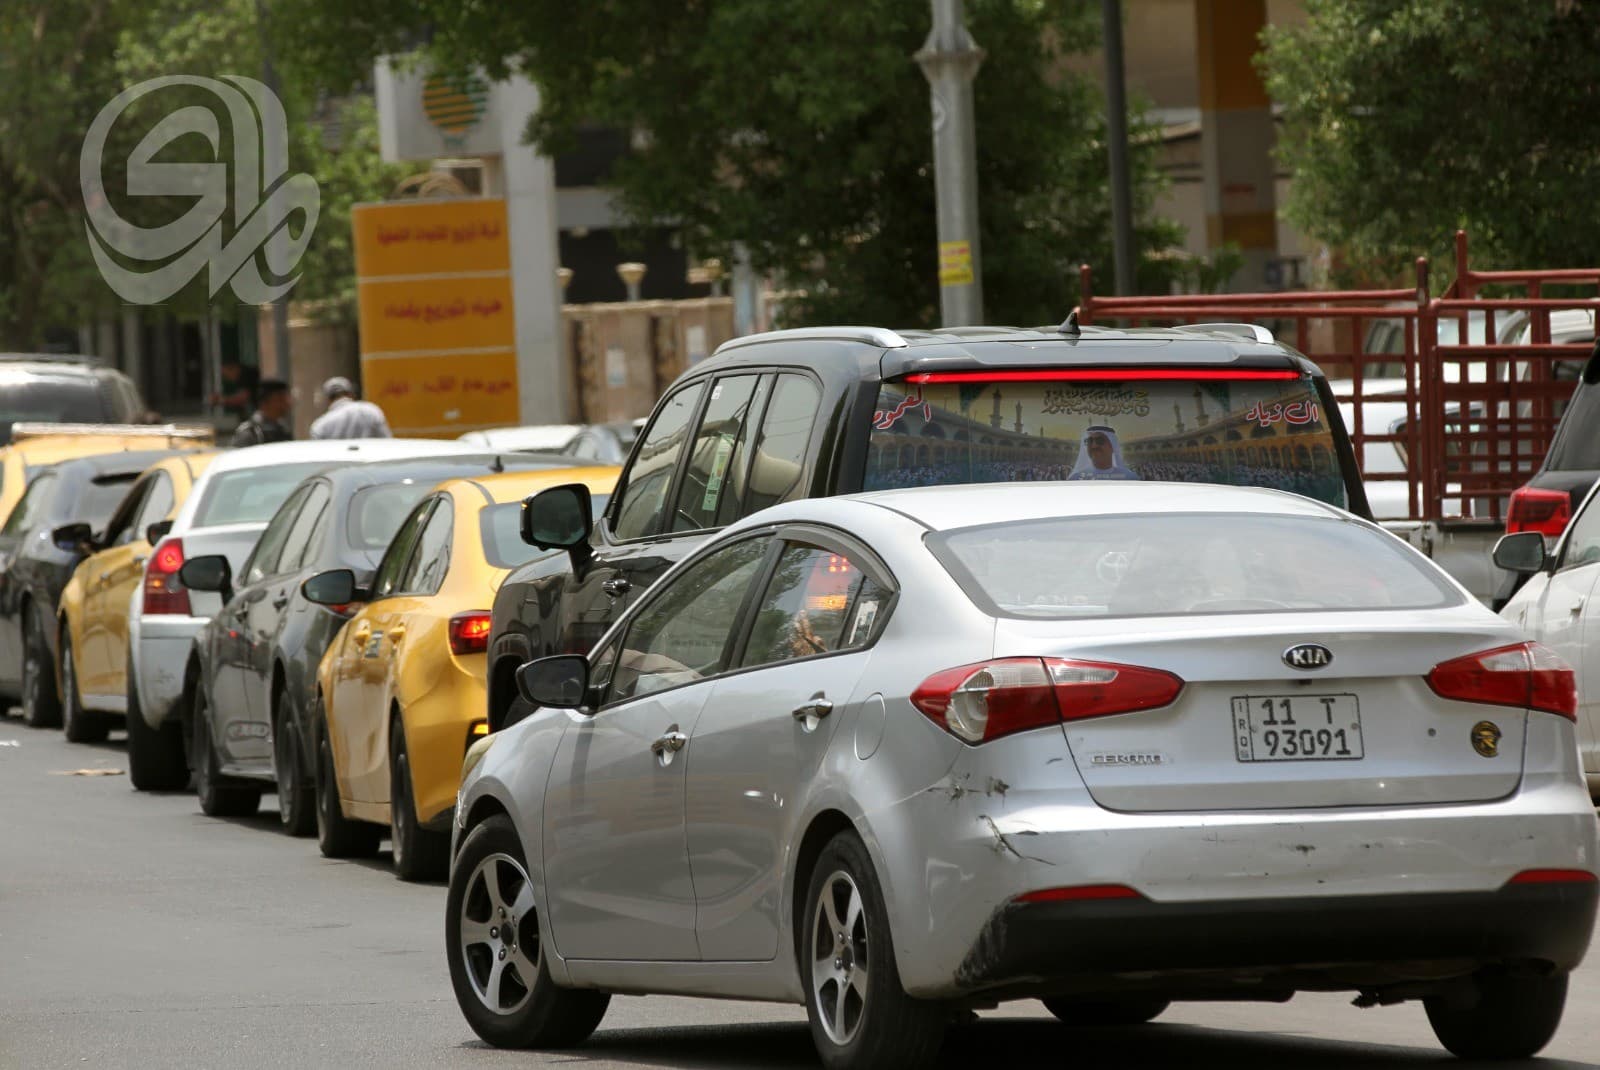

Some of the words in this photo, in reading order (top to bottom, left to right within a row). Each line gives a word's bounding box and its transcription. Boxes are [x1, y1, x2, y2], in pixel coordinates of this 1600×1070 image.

[1291, 648, 1328, 665] KIA
[1261, 698, 1297, 726] 11
[1319, 697, 1336, 725] T
[1263, 728, 1352, 757] 93091
